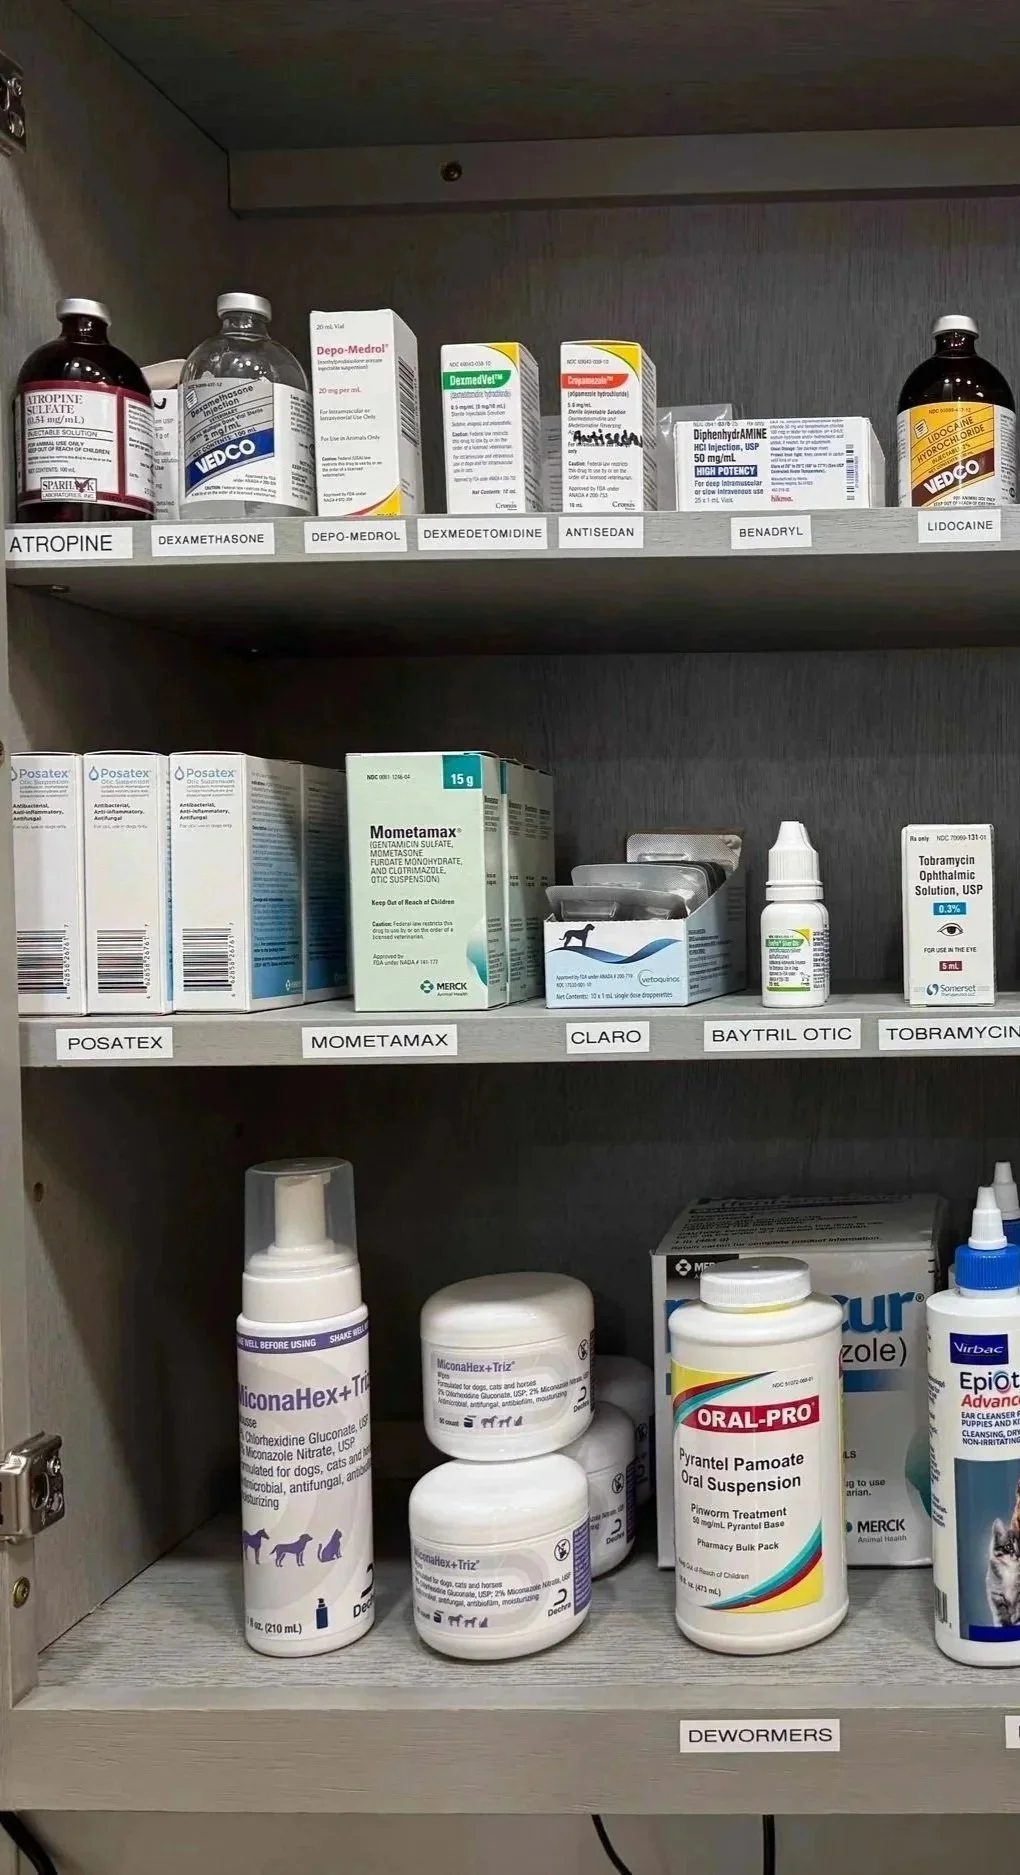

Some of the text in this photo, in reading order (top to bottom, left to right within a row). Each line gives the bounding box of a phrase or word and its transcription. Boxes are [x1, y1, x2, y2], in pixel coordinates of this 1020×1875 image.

[26, 394, 83, 405] ATROPINE
[191, 385, 254, 418] Dexamethasone
[26, 405, 75, 415] SULFATE
[202, 397, 240, 417] Injection
[693, 427, 767, 442] DiphenhydrAMINE
[928, 416, 974, 443] LIDOCAINE
[708, 443, 742, 454] Injection,
[745, 442, 759, 451] USP
[917, 424, 985, 463] HYDROCHLORIDE
[195, 440, 255, 474] VEDCO
[694, 453, 736, 465] 50 mg/mL
[696, 466, 755, 475] HIGH POTENCY
[924, 460, 980, 494] VEDCO
[565, 526, 634, 537] ANTISEDAN
[928, 520, 993, 531] LIDOCAINE
[158, 532, 264, 545] DEXAMETHASONE
[311, 532, 400, 542] DEPO-MEDROL
[424, 528, 542, 540] DEXMEDETOMIDINE
[739, 527, 803, 538] BENADRYL
[10, 534, 113, 552] ATROPINE
[19, 769, 68, 778] Posatex
[101, 768, 149, 778] Posatex
[186, 768, 235, 778] Posatex
[451, 774, 473, 787] 15 g
[370, 825, 462, 838] Mometamax®
[370, 840, 453, 849] (GENTAMICIN SULFATE,
[919, 855, 975, 867] Tobramycin
[919, 869, 975, 882] Ophthalmic
[915, 884, 983, 896] Solution, USP
[939, 904, 960, 914] 0.3%
[437, 982, 467, 990] MERCK
[940, 984, 976, 993] Somerset
[571, 1031, 641, 1043] CLARO
[712, 1028, 851, 1042] BAYTRIL OTIC
[68, 1037, 162, 1050] POSATEX
[312, 1034, 448, 1049] MOMETAMAX
[244, 1339, 316, 1349] WELL BEFORE USING
[954, 1342, 1004, 1355] Virbac
[961, 1419, 989, 1428] PUPPIES
[993, 1419, 1009, 1427] AND
[679, 1447, 804, 1471] Pyrantel Pamoate
[681, 1472, 801, 1496] Oral Suspension
[691, 1503, 787, 1519] Pinworm Treatment
[858, 1519, 906, 1533] MERCK
[548, 1602, 572, 1617] Dechra
[688, 1728, 833, 1743] DEWORMERS
